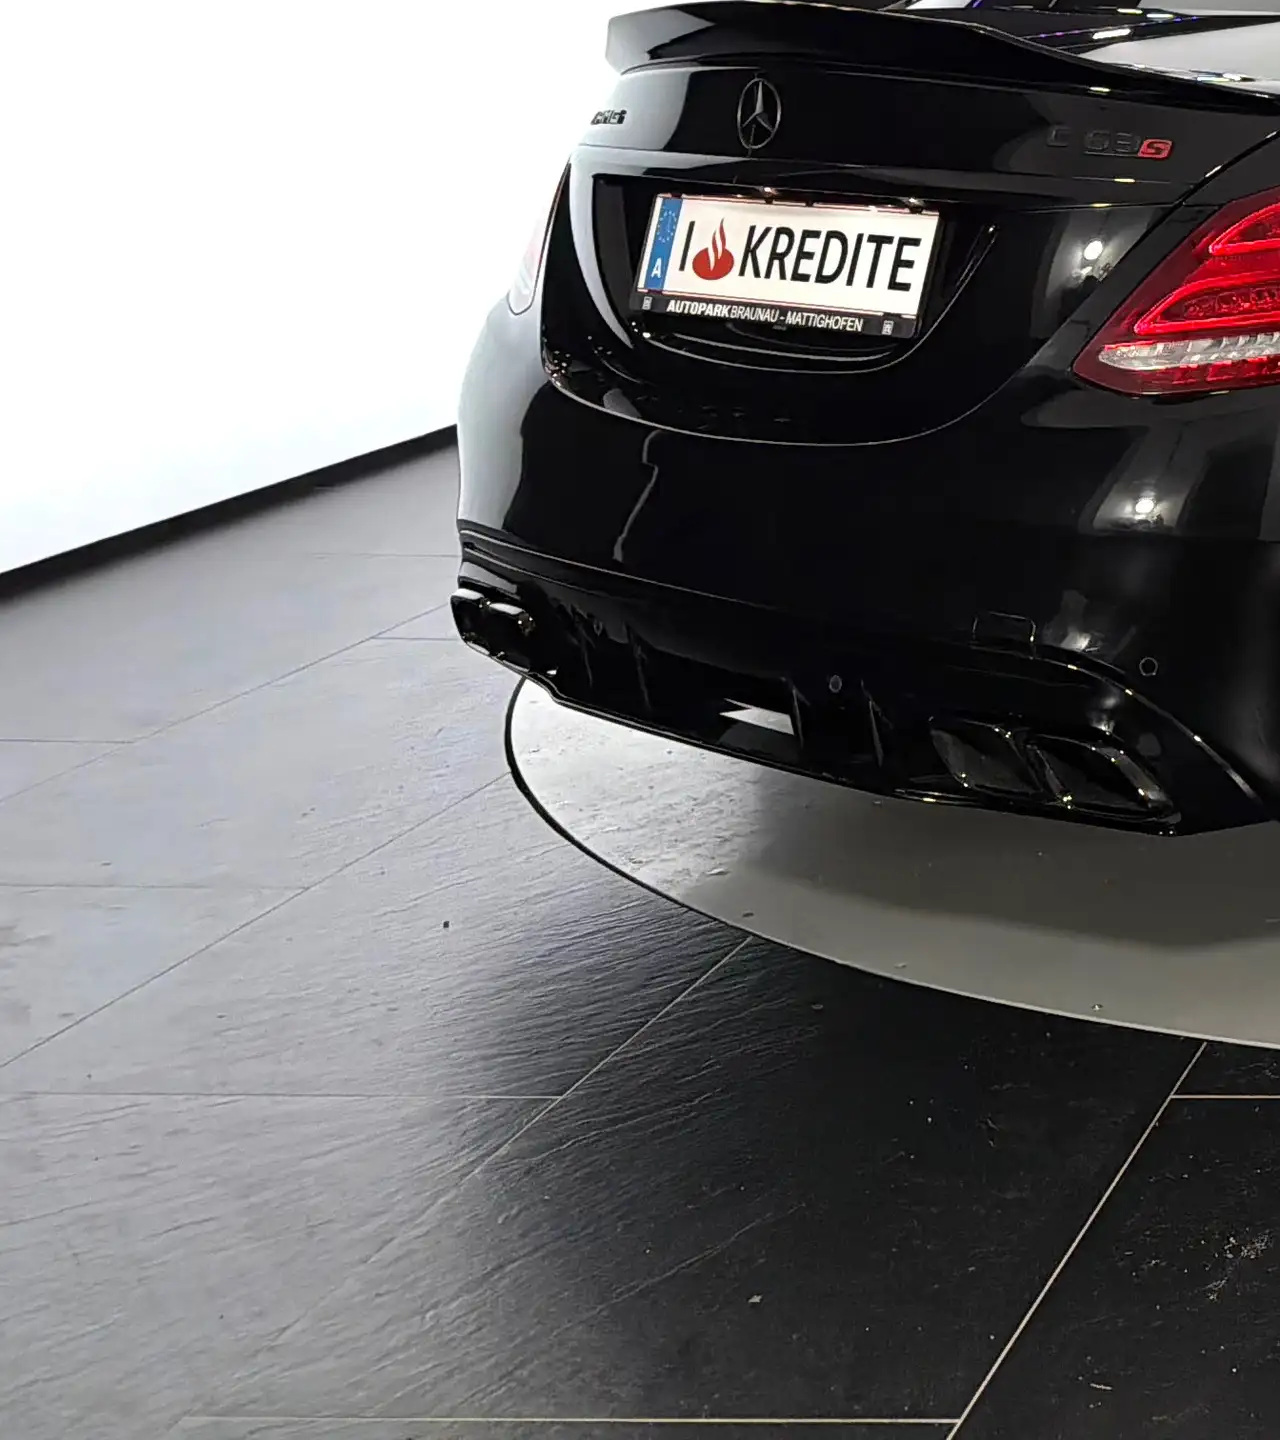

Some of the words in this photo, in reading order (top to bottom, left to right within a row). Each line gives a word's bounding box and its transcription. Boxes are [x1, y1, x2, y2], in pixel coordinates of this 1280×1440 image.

[651, 257, 663, 279] A
[738, 224, 922, 292] KREDITE
[786, 311, 864, 333] MATTIGHOFEN
